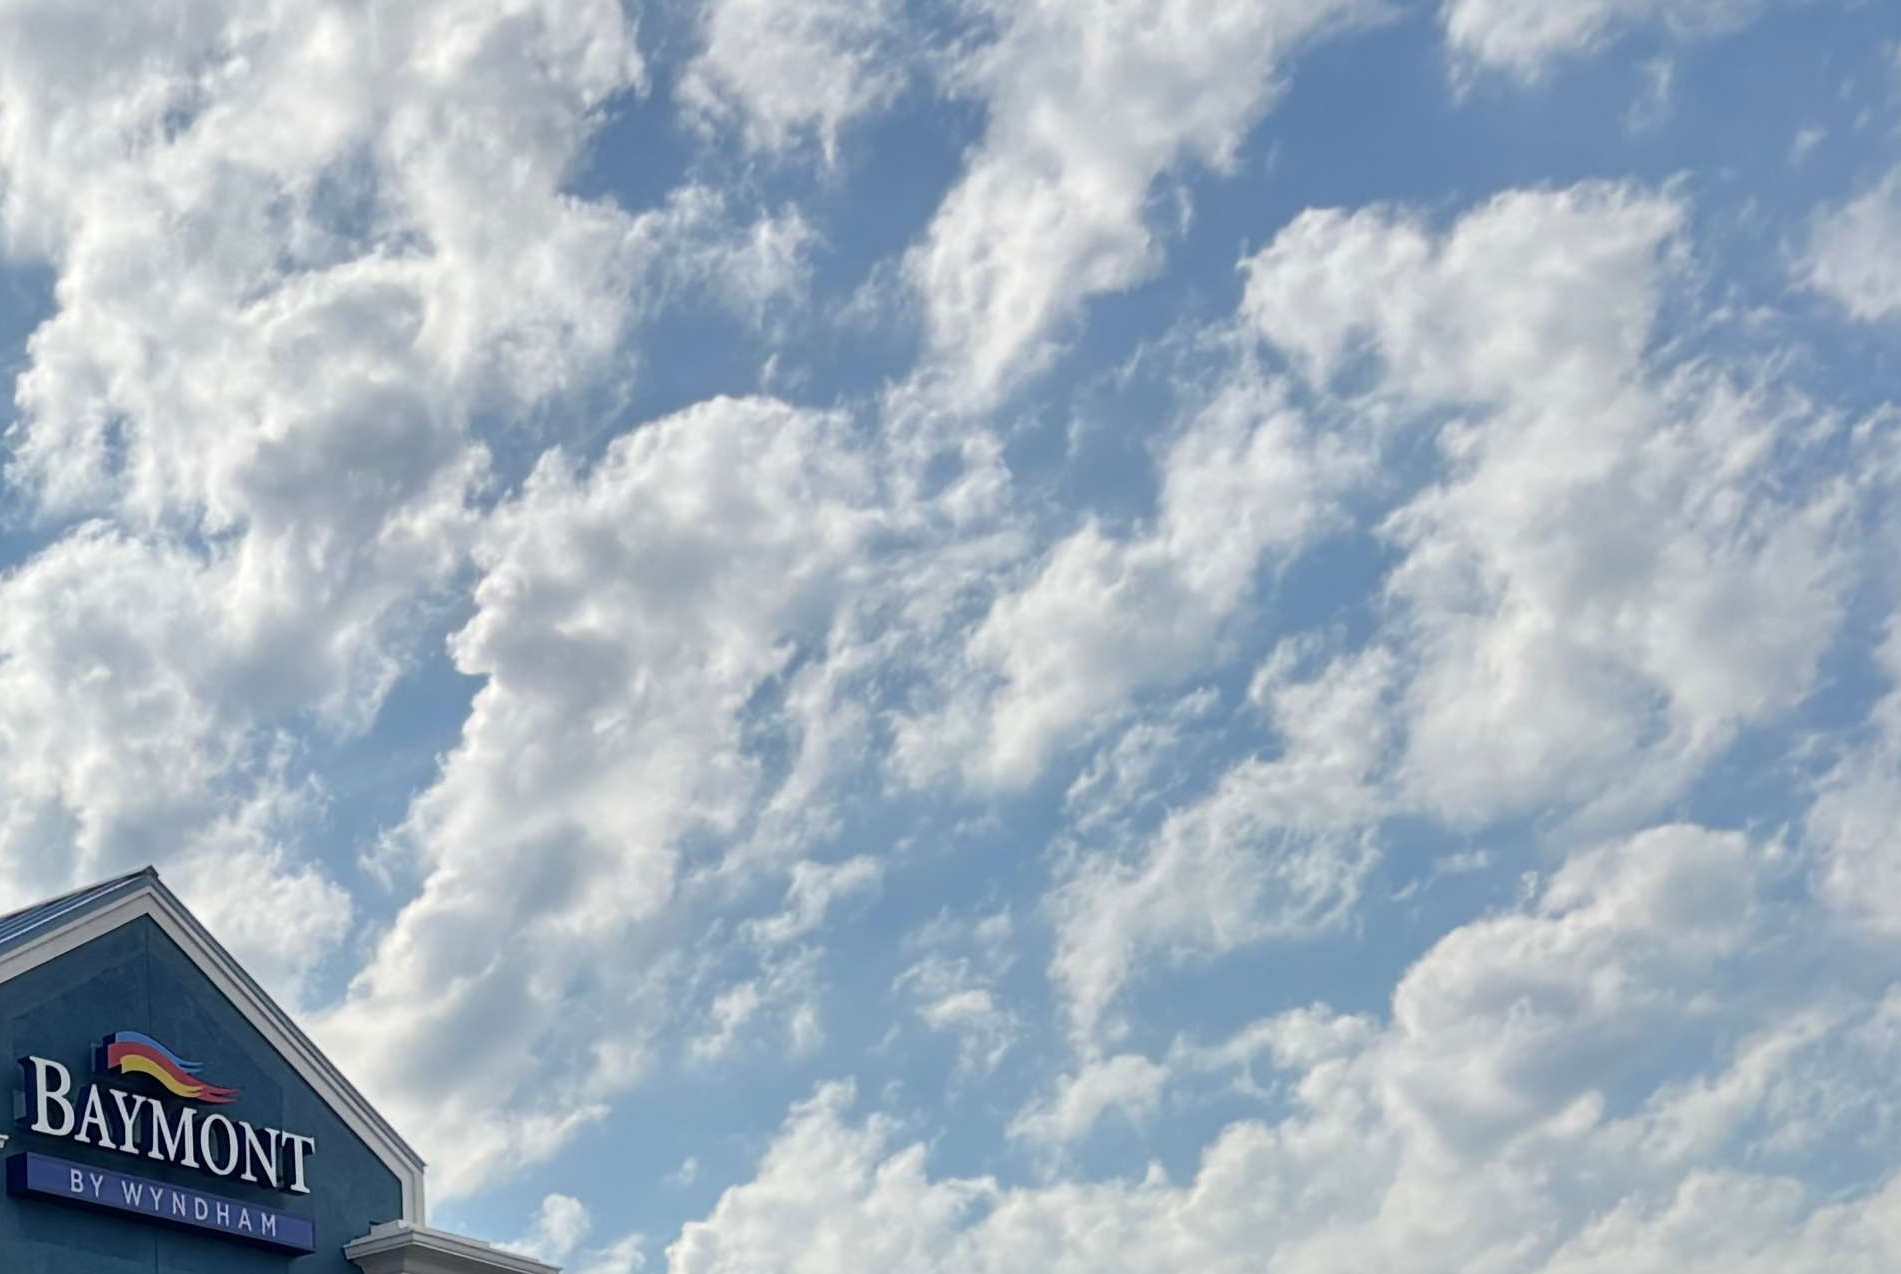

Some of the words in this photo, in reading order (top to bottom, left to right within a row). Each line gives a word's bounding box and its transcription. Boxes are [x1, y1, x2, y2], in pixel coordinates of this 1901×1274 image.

[28, 1054, 316, 1194] BAYMONT
[69, 1168, 105, 1197] BY
[121, 1180, 277, 1238] WYNDHAM
